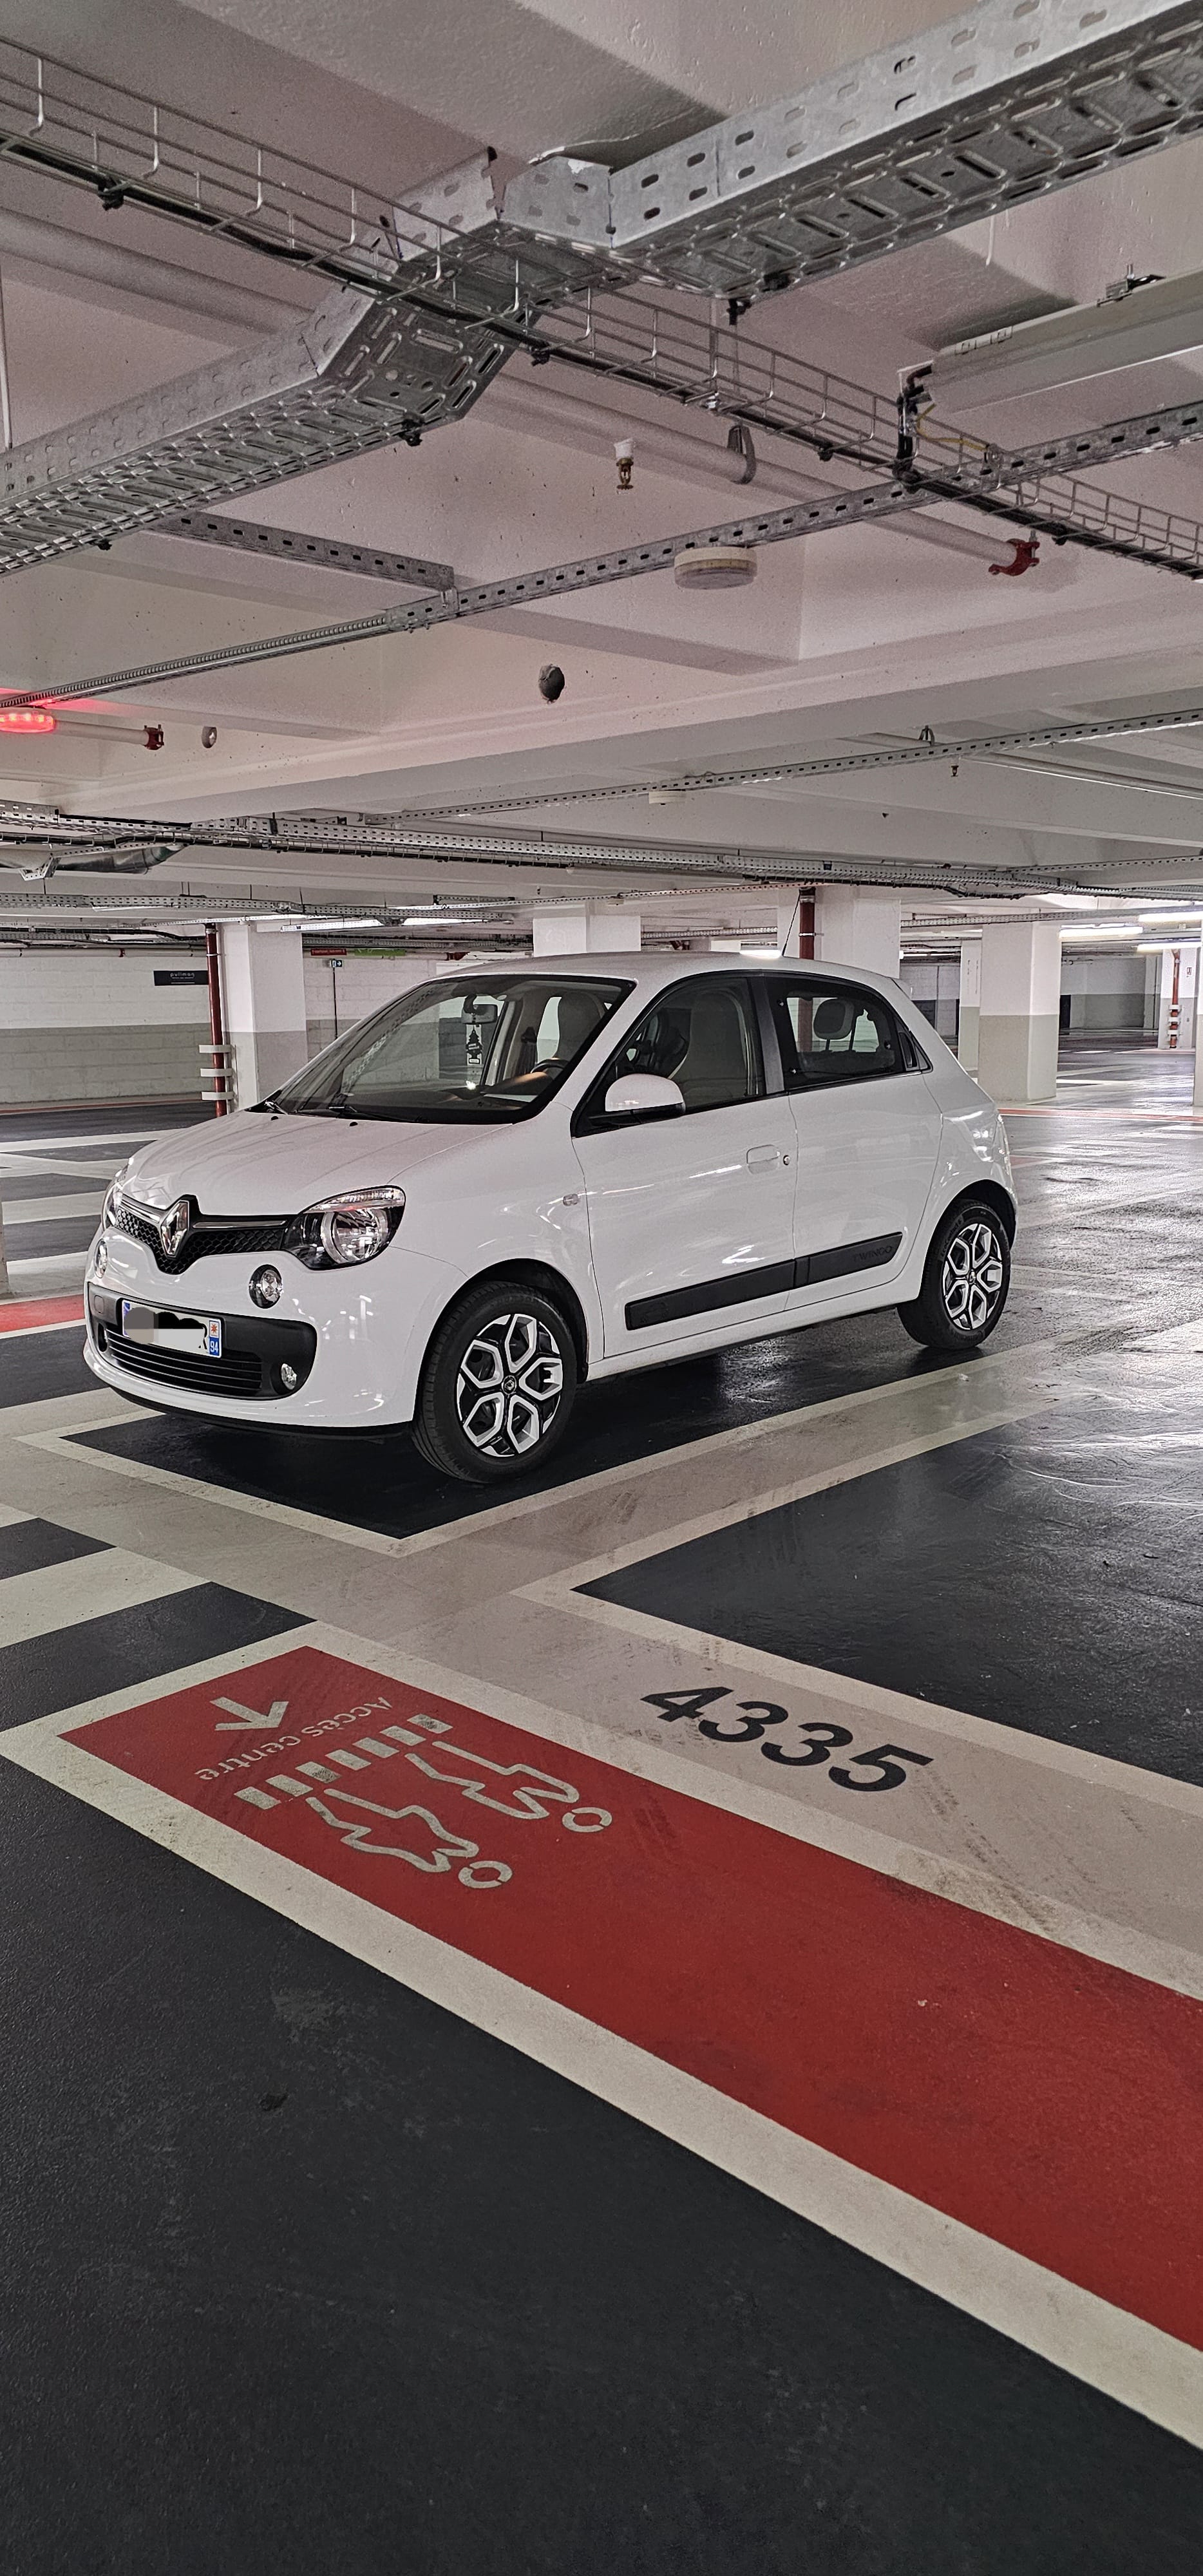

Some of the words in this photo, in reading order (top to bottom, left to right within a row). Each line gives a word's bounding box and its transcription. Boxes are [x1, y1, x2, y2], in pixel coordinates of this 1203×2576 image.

[210, 1341, 218, 1353] 94
[301, 1696, 393, 1738] Accès
[640, 1686, 934, 1792] 4335
[194, 1735, 301, 1781] centre
